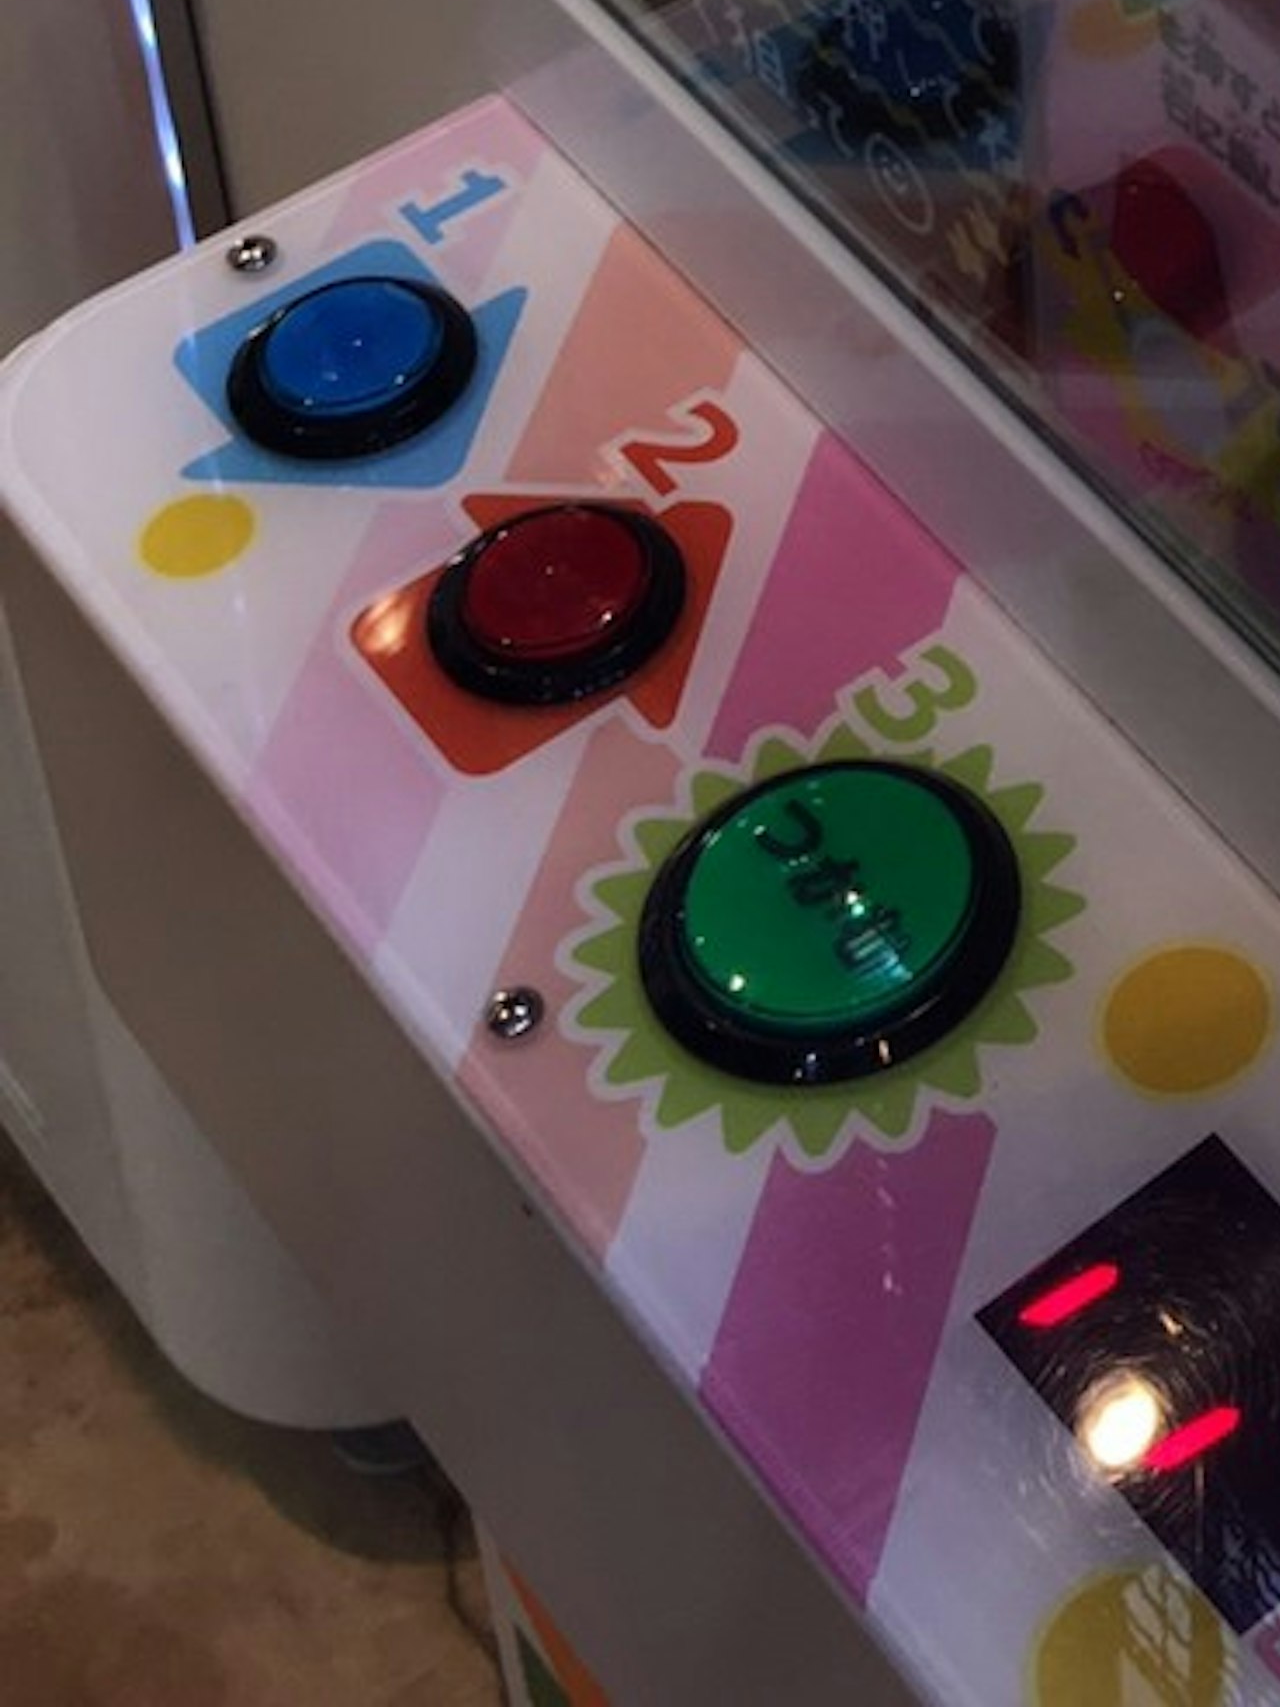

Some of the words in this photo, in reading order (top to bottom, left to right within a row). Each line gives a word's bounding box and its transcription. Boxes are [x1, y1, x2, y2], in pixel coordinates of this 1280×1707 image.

[399, 169, 509, 247] 1
[622, 401, 740, 499] 2
[852, 644, 979, 742] 3
